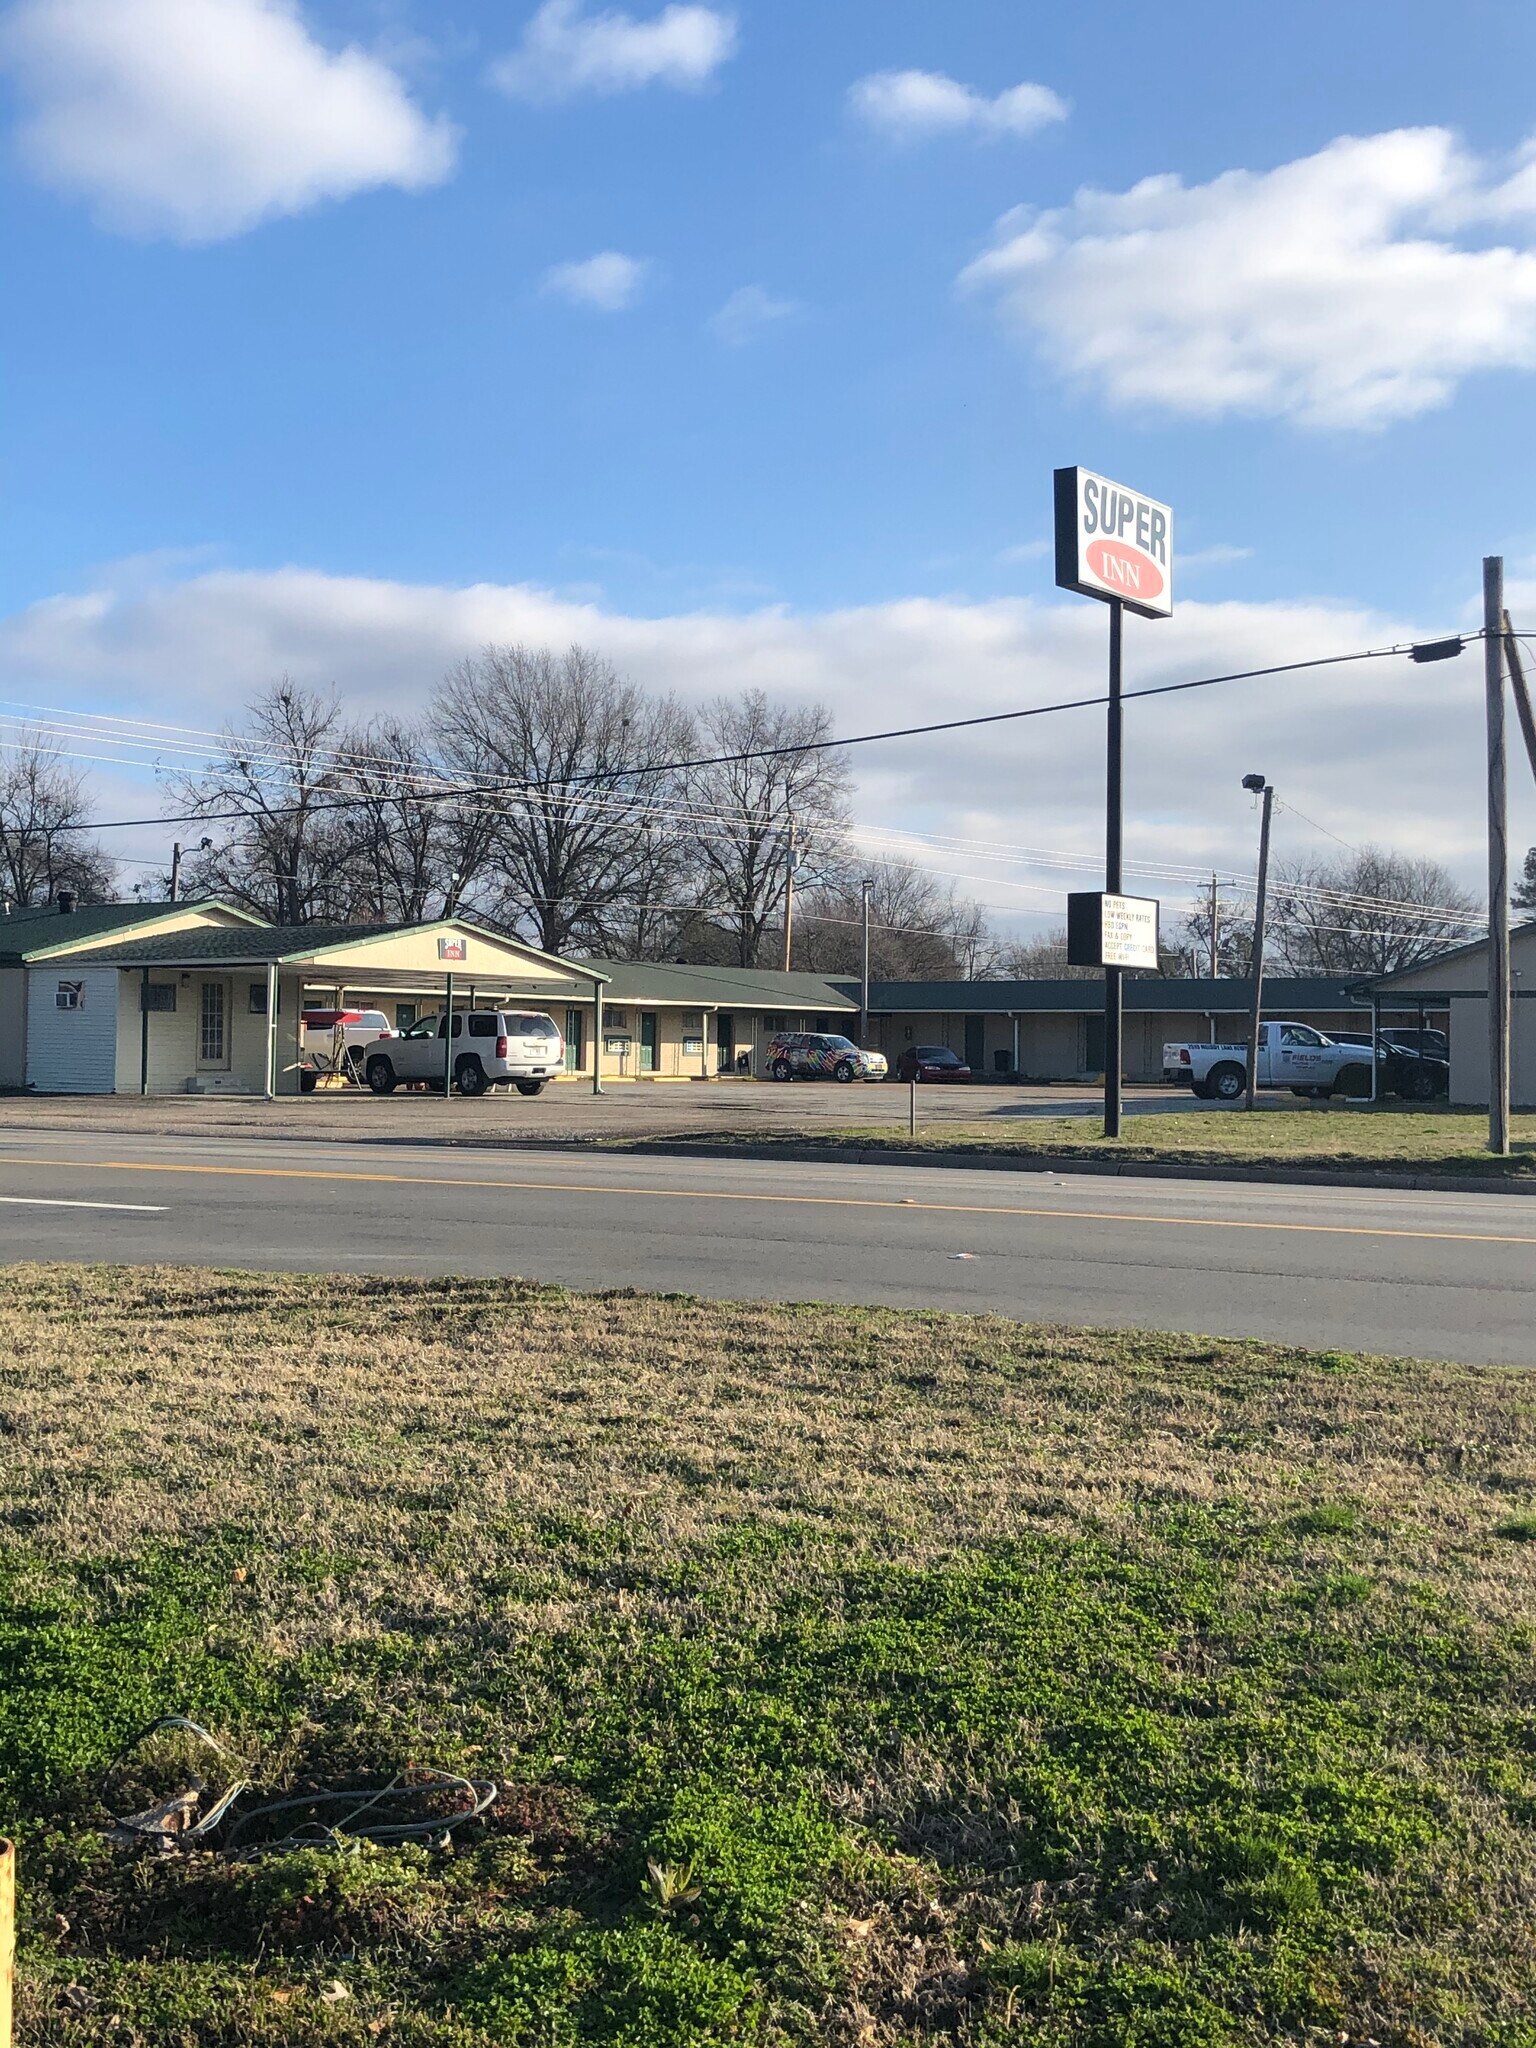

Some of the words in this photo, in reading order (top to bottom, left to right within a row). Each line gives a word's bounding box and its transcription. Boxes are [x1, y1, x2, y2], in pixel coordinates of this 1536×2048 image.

[1084, 479, 1166, 567] SUPER
[1101, 552, 1141, 590] INN
[1105, 899, 1111, 908] NO
[1113, 900, 1126, 910] PETS
[1105, 910, 1115, 919] LOW
[1116, 911, 1135, 921] WEEKLY
[1136, 913, 1151, 923] RATES
[1116, 921, 1129, 930] ESPN
[1105, 930, 1113, 939] FAX
[1120, 932, 1132, 941] COPY
[445, 938, 462, 950] SUPER
[1105, 941, 1123, 950] ACCEPT
[1124, 943, 1141, 952] CREDIT
[447, 950, 460, 958] INN
[1105, 951, 1116, 960] FREE
[1291, 1054, 1322, 1062] FIELDS
